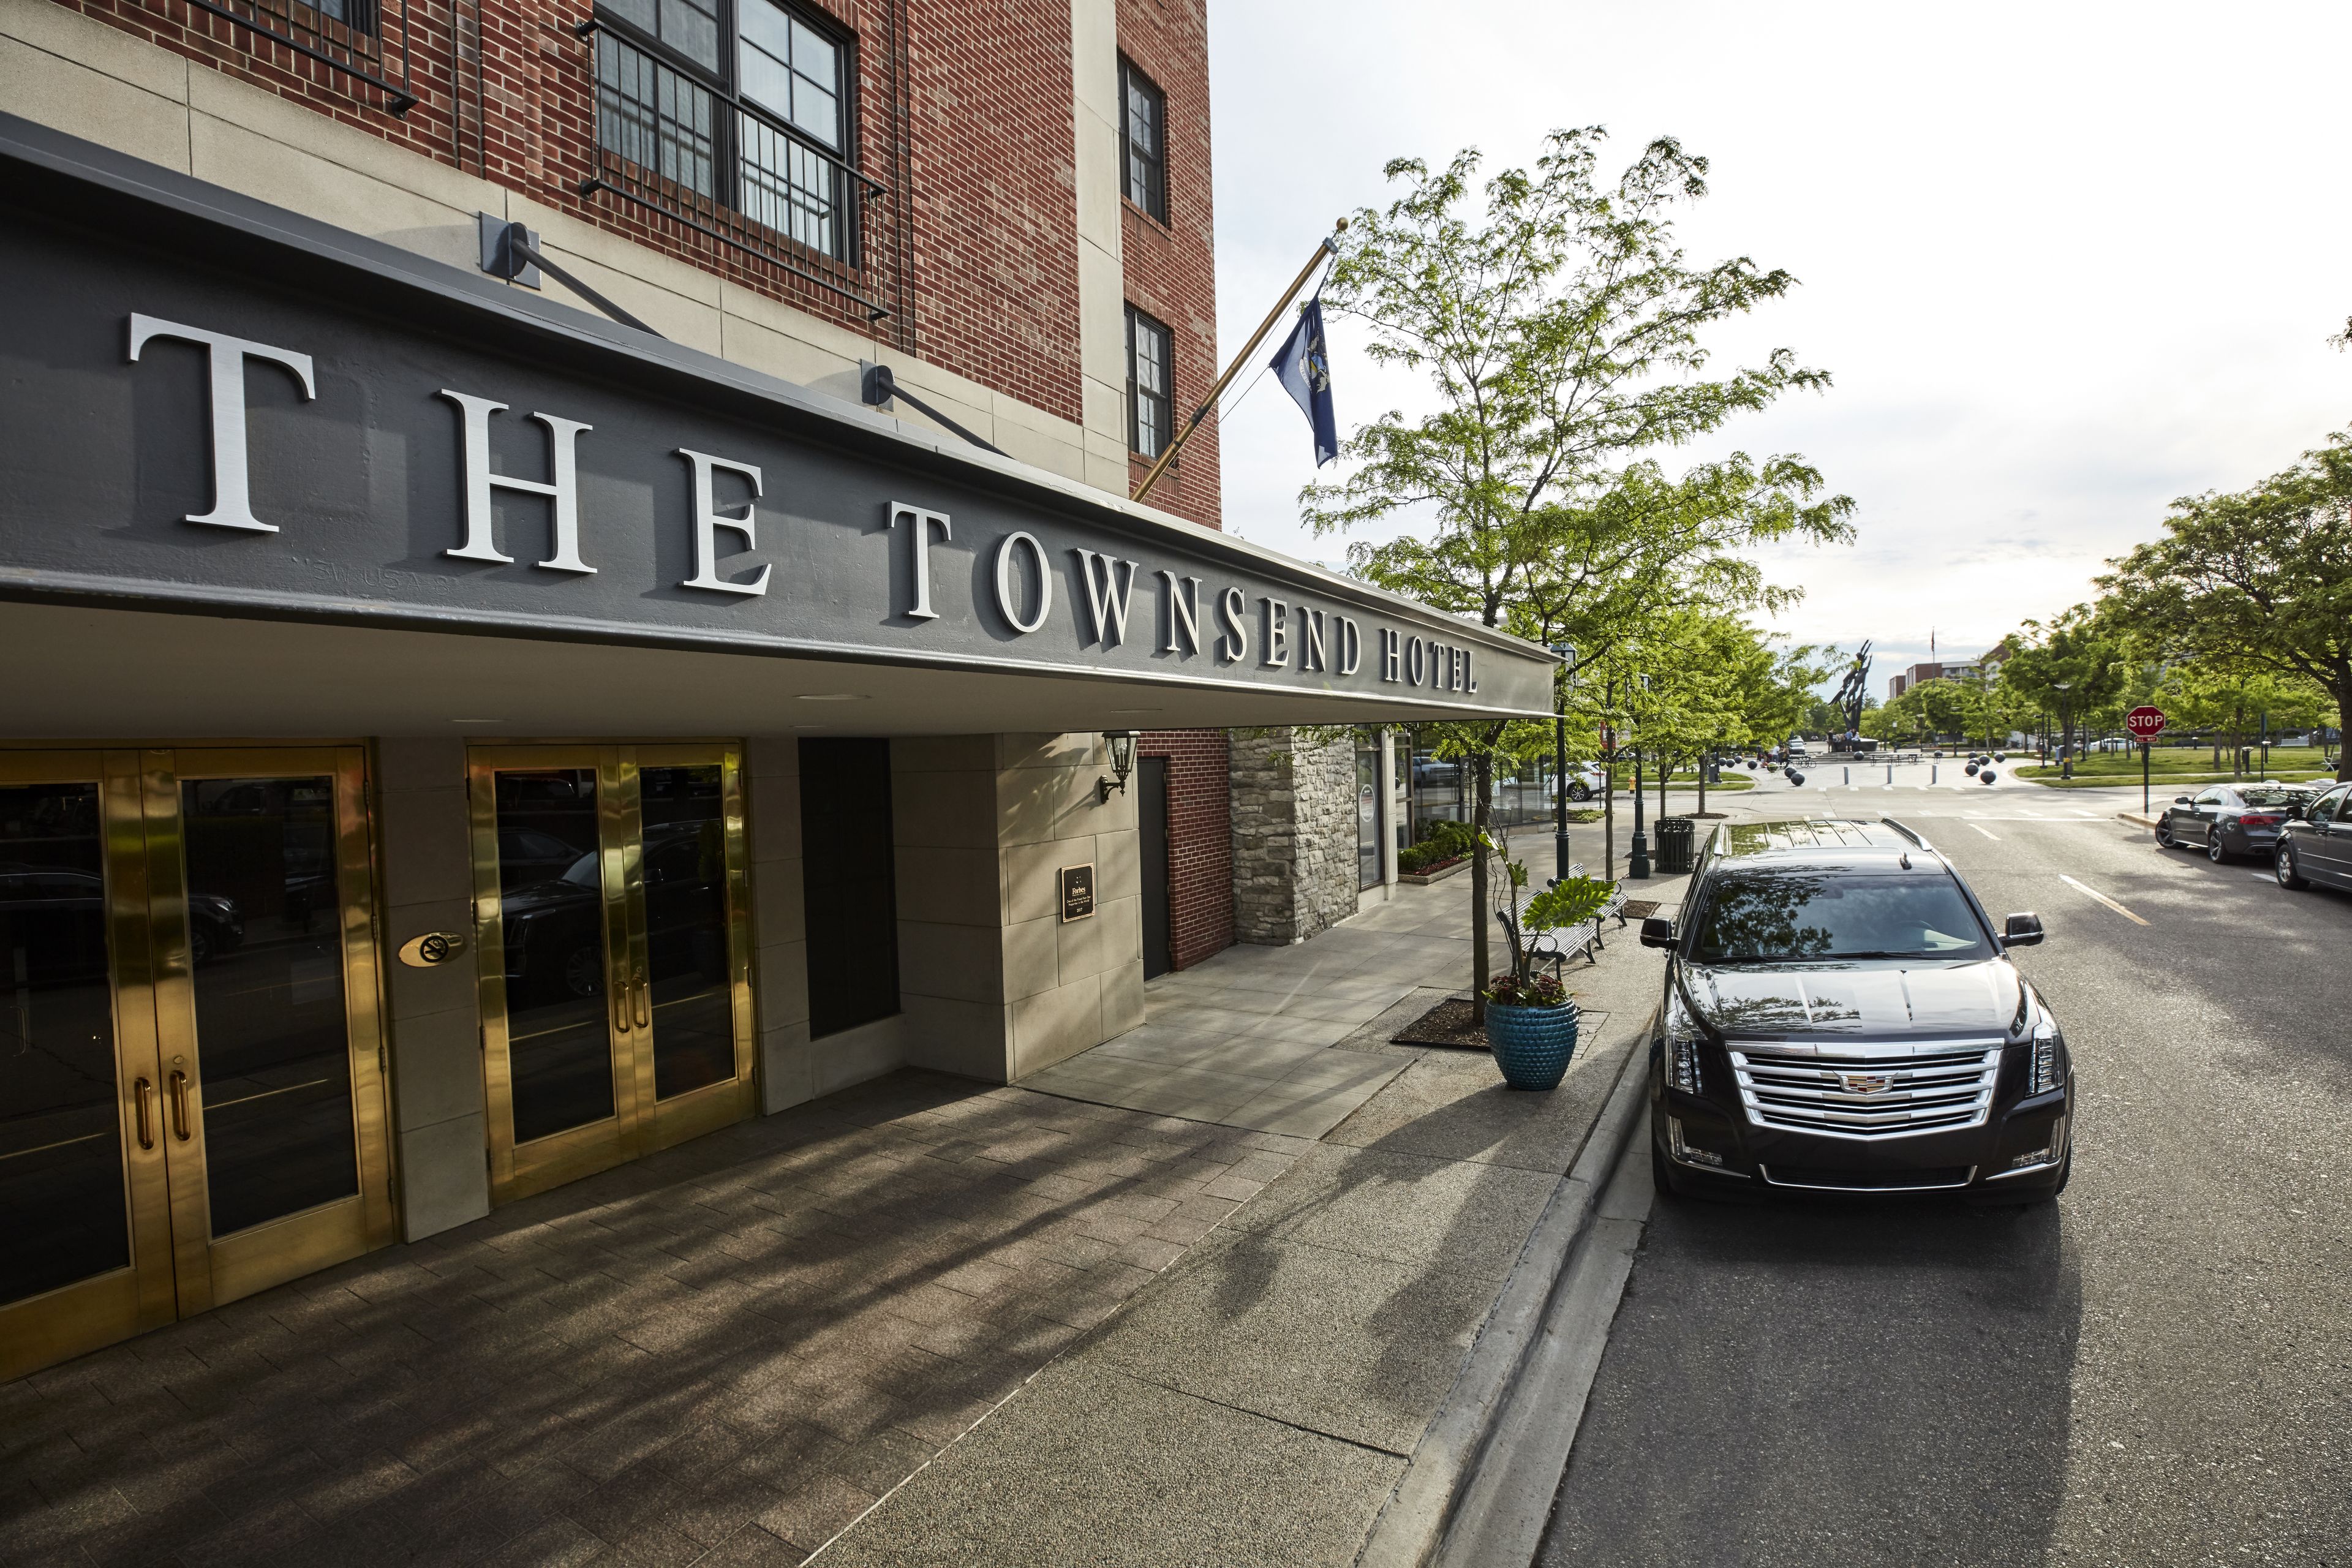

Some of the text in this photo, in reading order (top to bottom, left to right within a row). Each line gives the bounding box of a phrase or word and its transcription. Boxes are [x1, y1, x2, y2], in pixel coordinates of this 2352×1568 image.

[128, 311, 1479, 695] THE TOWNSEND HOTEL
[363, 564, 422, 592] USA
[2129, 715, 2163, 727] STOP
